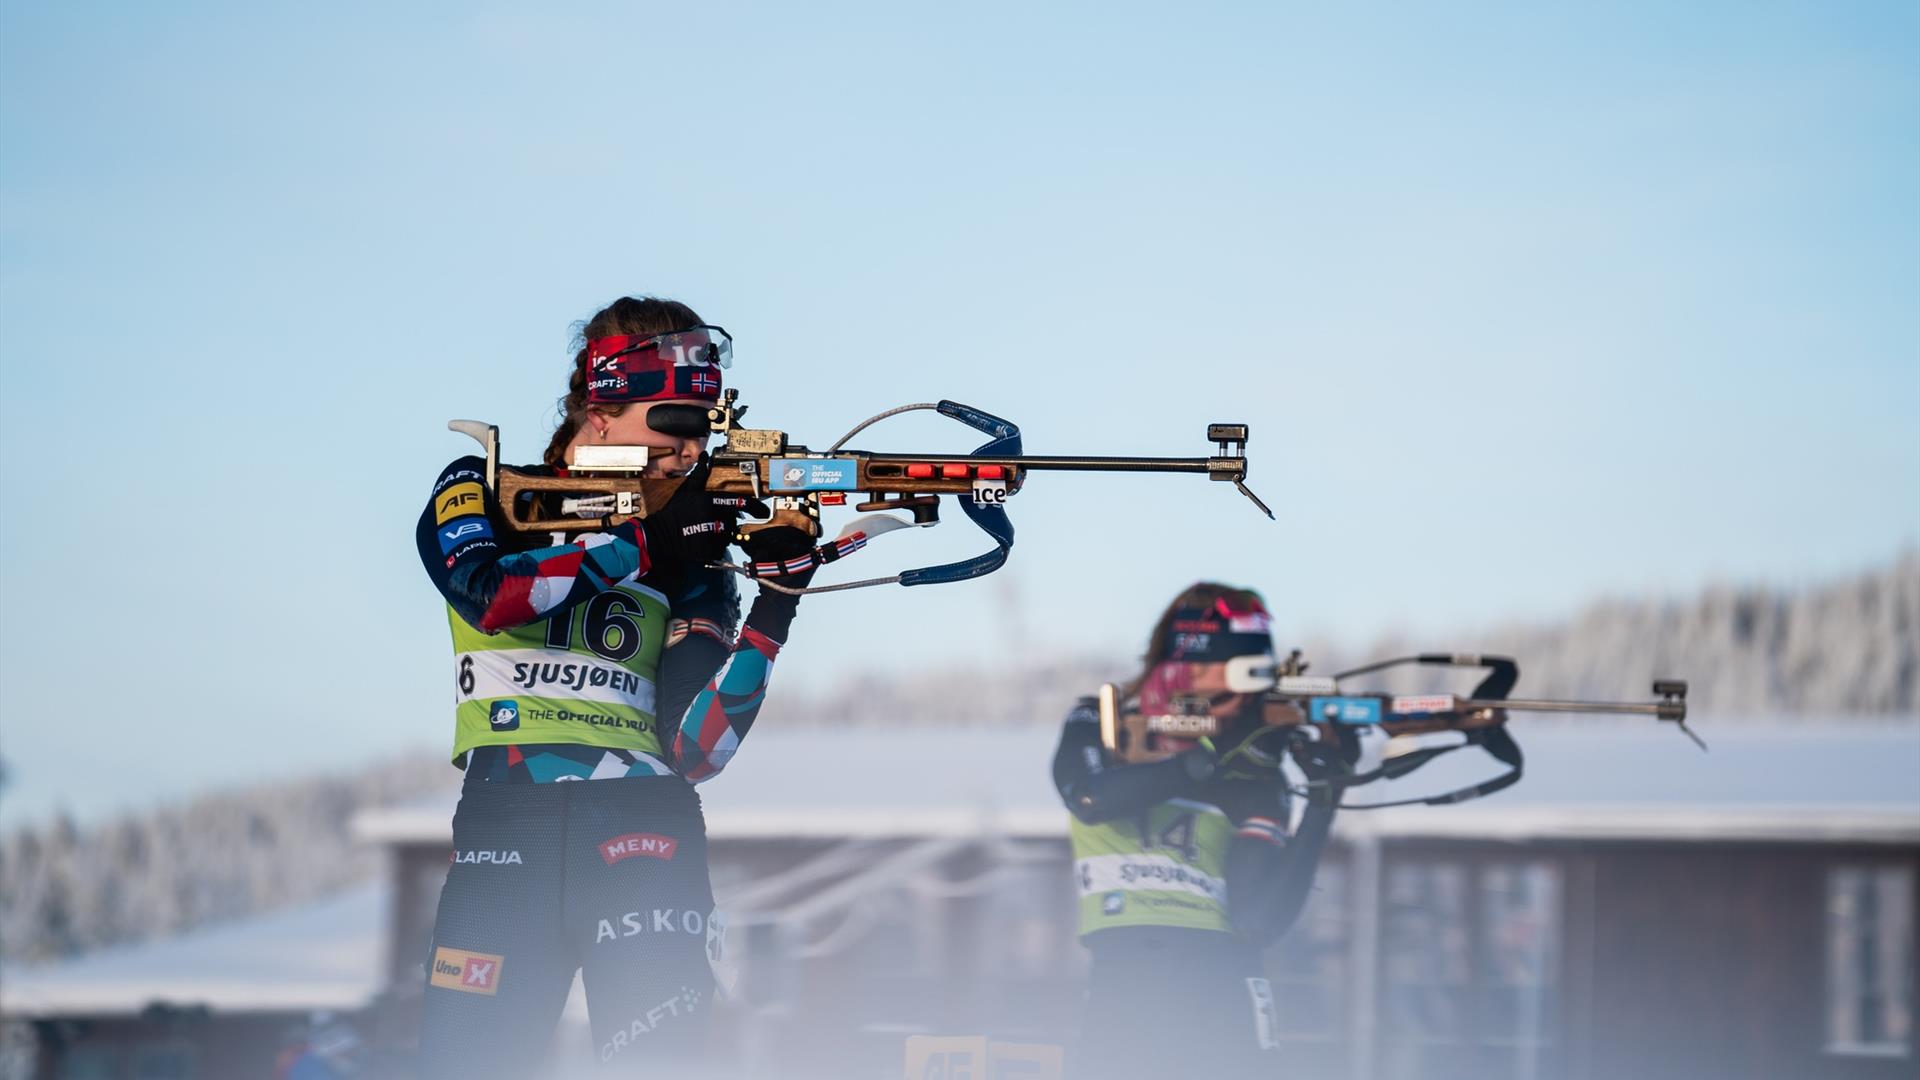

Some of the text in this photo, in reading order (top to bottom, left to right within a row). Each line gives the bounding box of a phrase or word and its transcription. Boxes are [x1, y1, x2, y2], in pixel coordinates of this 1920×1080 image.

[588, 379, 617, 391] CRAFT
[433, 470, 484, 495] RAFT
[440, 493, 479, 514] AF
[445, 523, 484, 539] VB
[455, 541, 498, 557] LAPUA
[544, 590, 645, 663] 16
[513, 662, 639, 696] SJUSJØEN
[528, 709, 554, 720] THE
[557, 711, 623, 728] OFFICIAL
[455, 850, 523, 865] LAPUA
[607, 839, 670, 857] MENY
[596, 909, 704, 943] ASKO
[435, 959, 493, 985] Uno X
[602, 996, 681, 1064] CRAFT
